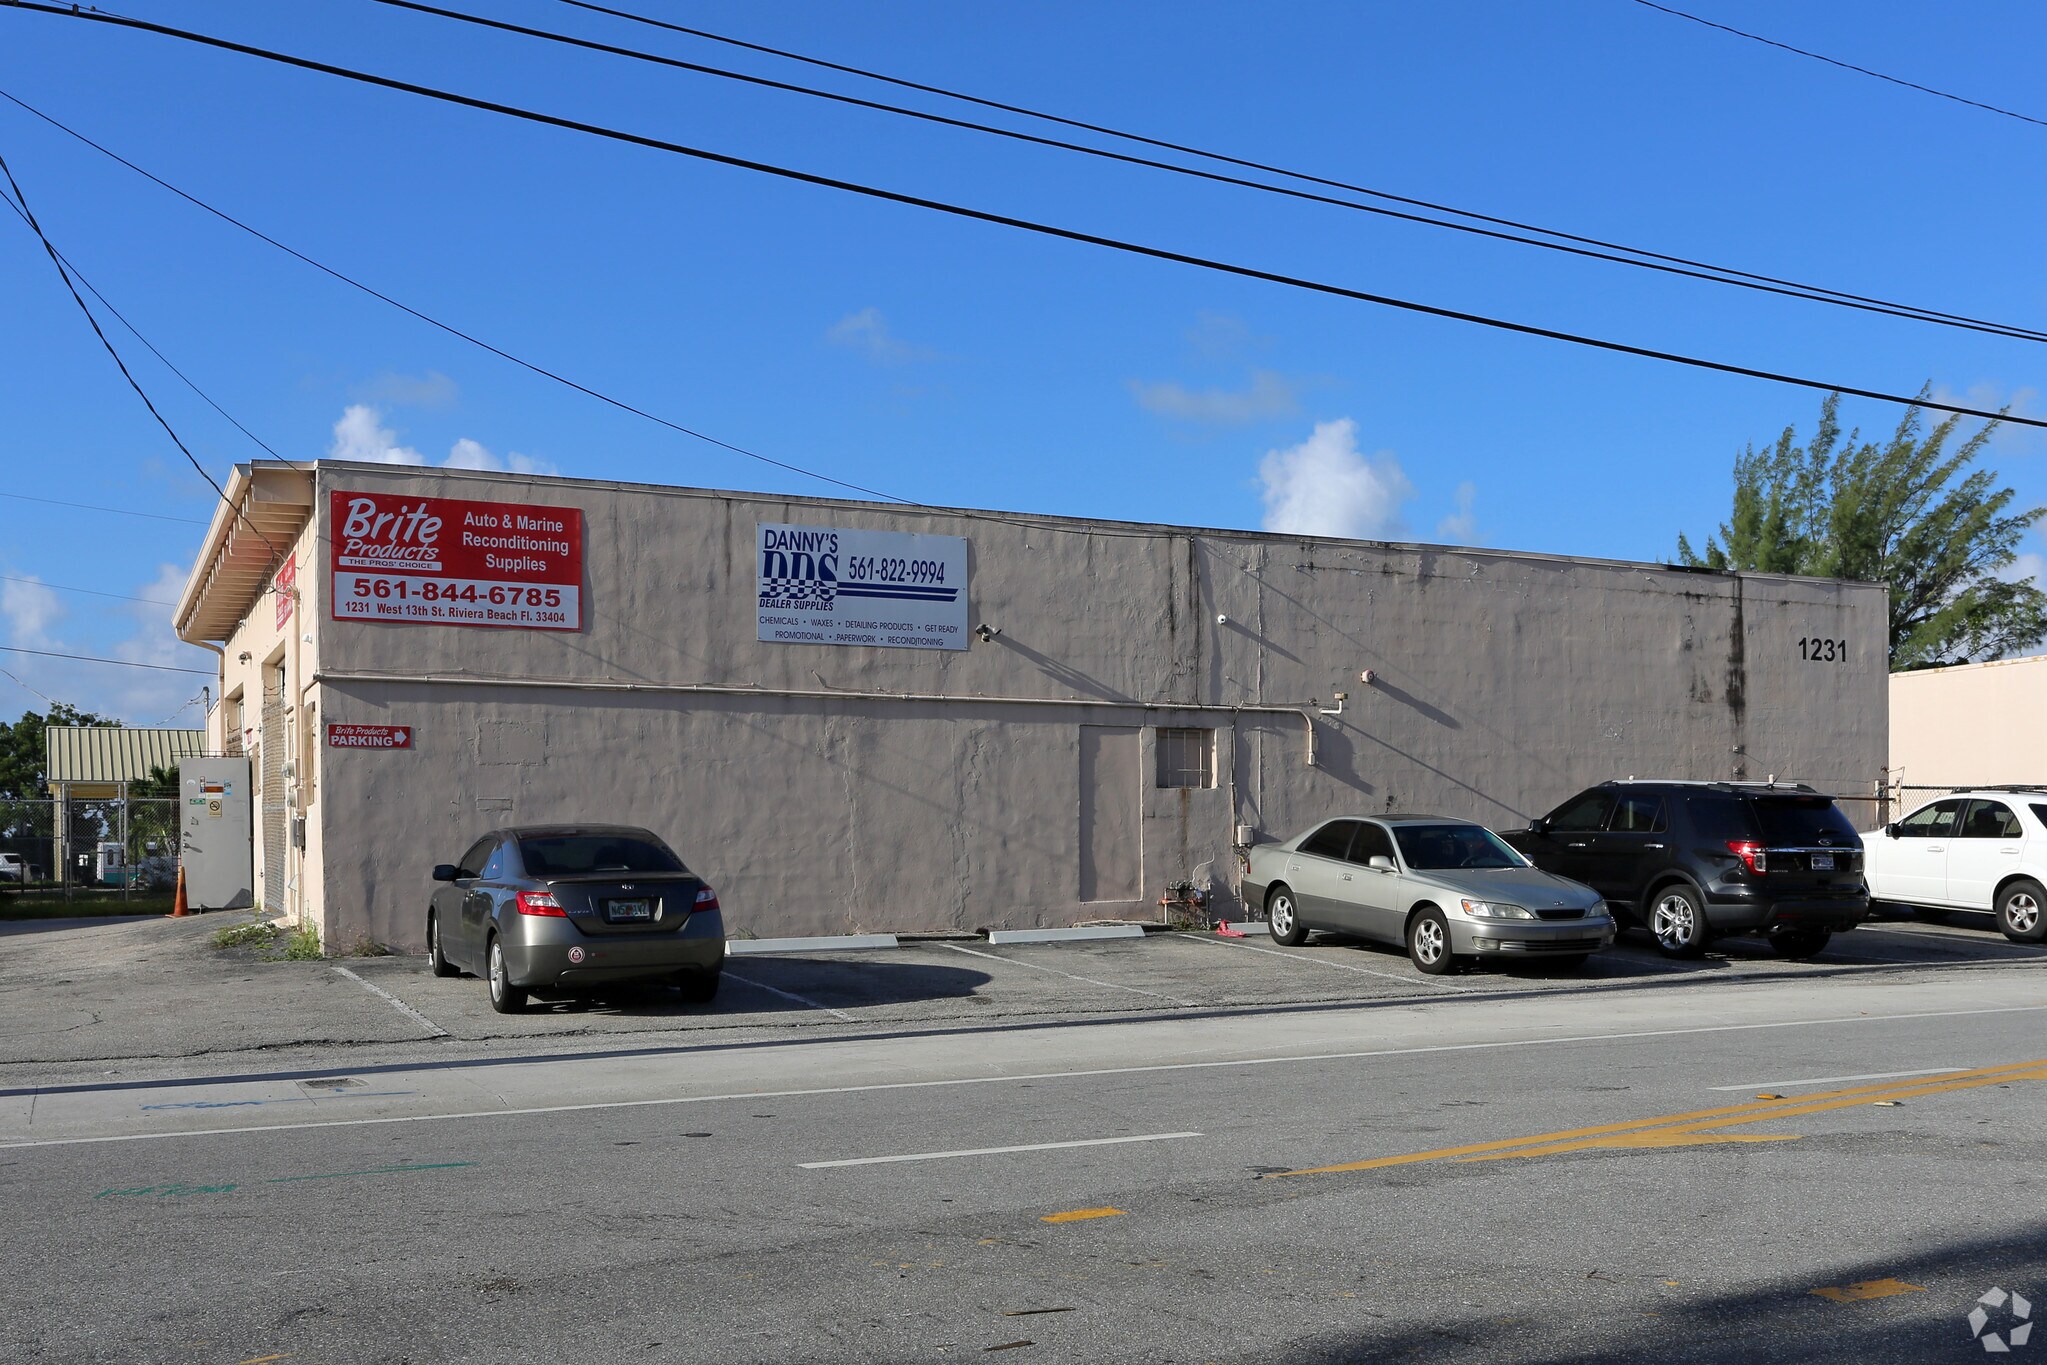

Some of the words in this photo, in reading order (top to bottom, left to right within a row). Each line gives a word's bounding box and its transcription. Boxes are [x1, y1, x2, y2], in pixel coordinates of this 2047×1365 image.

[342, 498, 443, 544] Brite
[463, 511, 498, 528] Auto
[502, 514, 513, 529] &
[516, 515, 563, 533] Marine
[343, 538, 440, 561] Products
[462, 531, 569, 557] Reconditioning
[764, 529, 838, 554] DANNY'S
[348, 558, 367, 566] THE
[398, 561, 433, 570] CHOICE
[485, 553, 547, 573] Supplies
[848, 556, 945, 585] 561-822-9994
[759, 550, 838, 602] DDS
[353, 578, 561, 608] 561-844-6785
[345, 601, 370, 613] 1231
[377, 603, 402, 615] West
[406, 605, 428, 616] 13th
[431, 606, 445, 617] St.
[448, 607, 484, 619] Riviera
[487, 609, 518, 620] Beach
[535, 611, 566, 623] 33404
[759, 598, 791, 609] DEALER
[793, 600, 834, 612] SUPPLIES
[759, 616, 799, 626] CHEMICALS
[810, 619, 833, 627] WAXES
[845, 620, 878, 630] DETAILING
[879, 622, 914, 632] PRODUCTS
[924, 624, 937, 633] GET
[938, 625, 958, 634] READY
[775, 630, 825, 641] PROMOTIONAL
[836, 633, 876, 643] PAPERWORK
[1798, 637, 1847, 663] 1231
[331, 735, 393, 747] PARKING
[335, 726, 355, 735] Brite
[355, 727, 389, 736] Products
